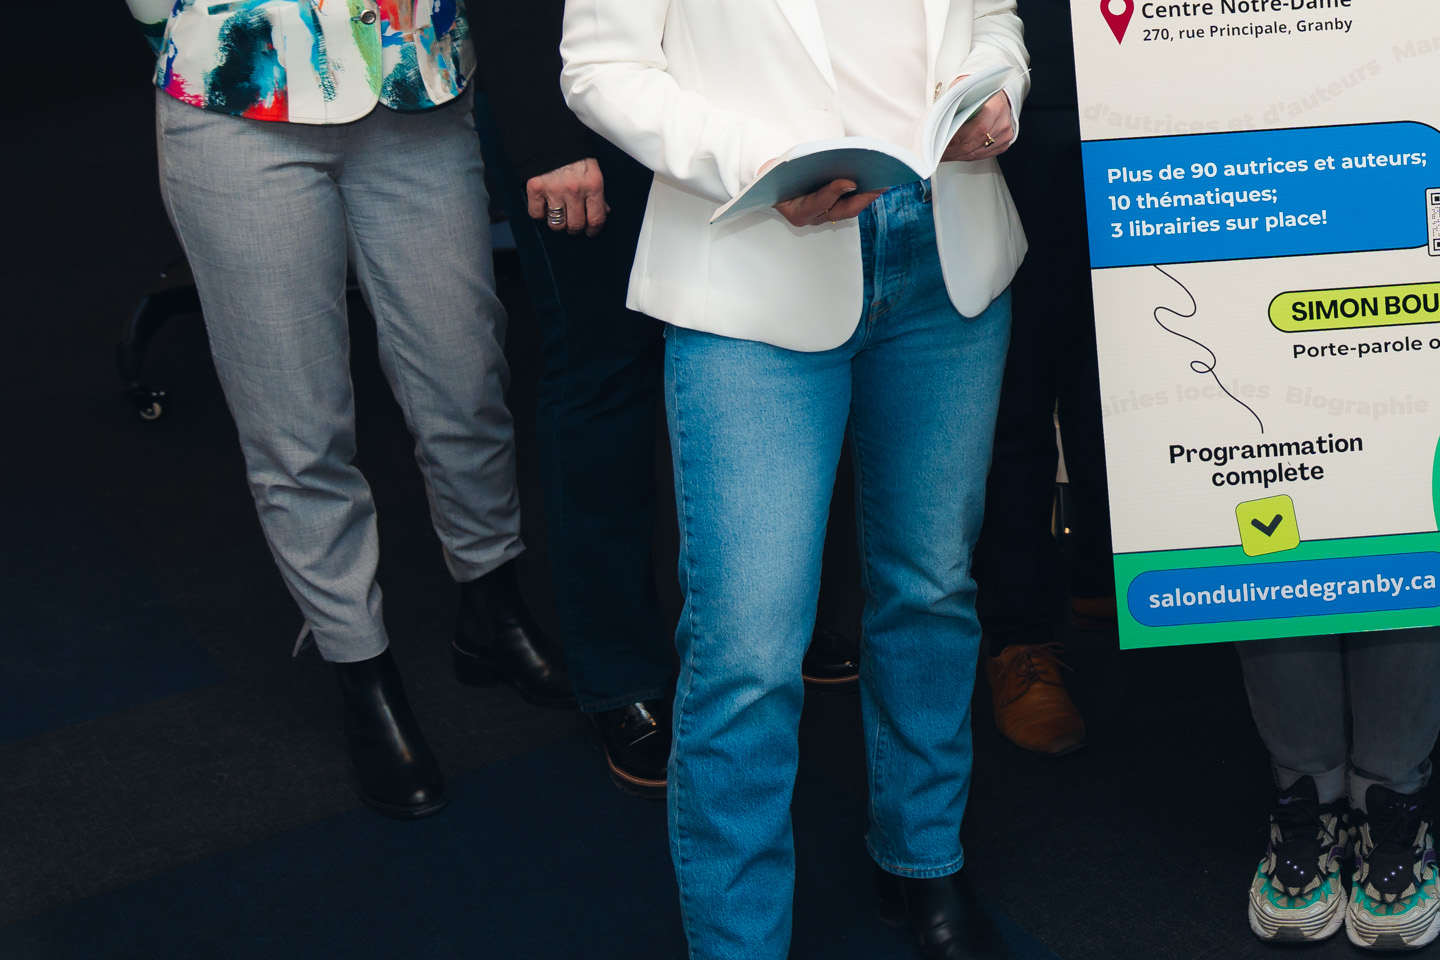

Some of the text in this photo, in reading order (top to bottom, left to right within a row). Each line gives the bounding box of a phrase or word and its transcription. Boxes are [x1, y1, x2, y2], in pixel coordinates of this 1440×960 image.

[1142, 2, 1213, 18] Centre
[1143, 18, 1352, 41] 270, rue Principale, Granby
[1108, 153, 1426, 183] Plus de 90 autrices et auteurs;
[1108, 188, 1277, 210] 10 thématiques;
[1111, 210, 1327, 238] 3 librairies sur place!
[1292, 297, 1378, 321] SIMON
[1294, 336, 1422, 358] Porte-parole
[1170, 434, 1362, 466] Programmation
[1212, 456, 1324, 488] complète
[1150, 574, 1435, 608] salondulivredegranby.ca
